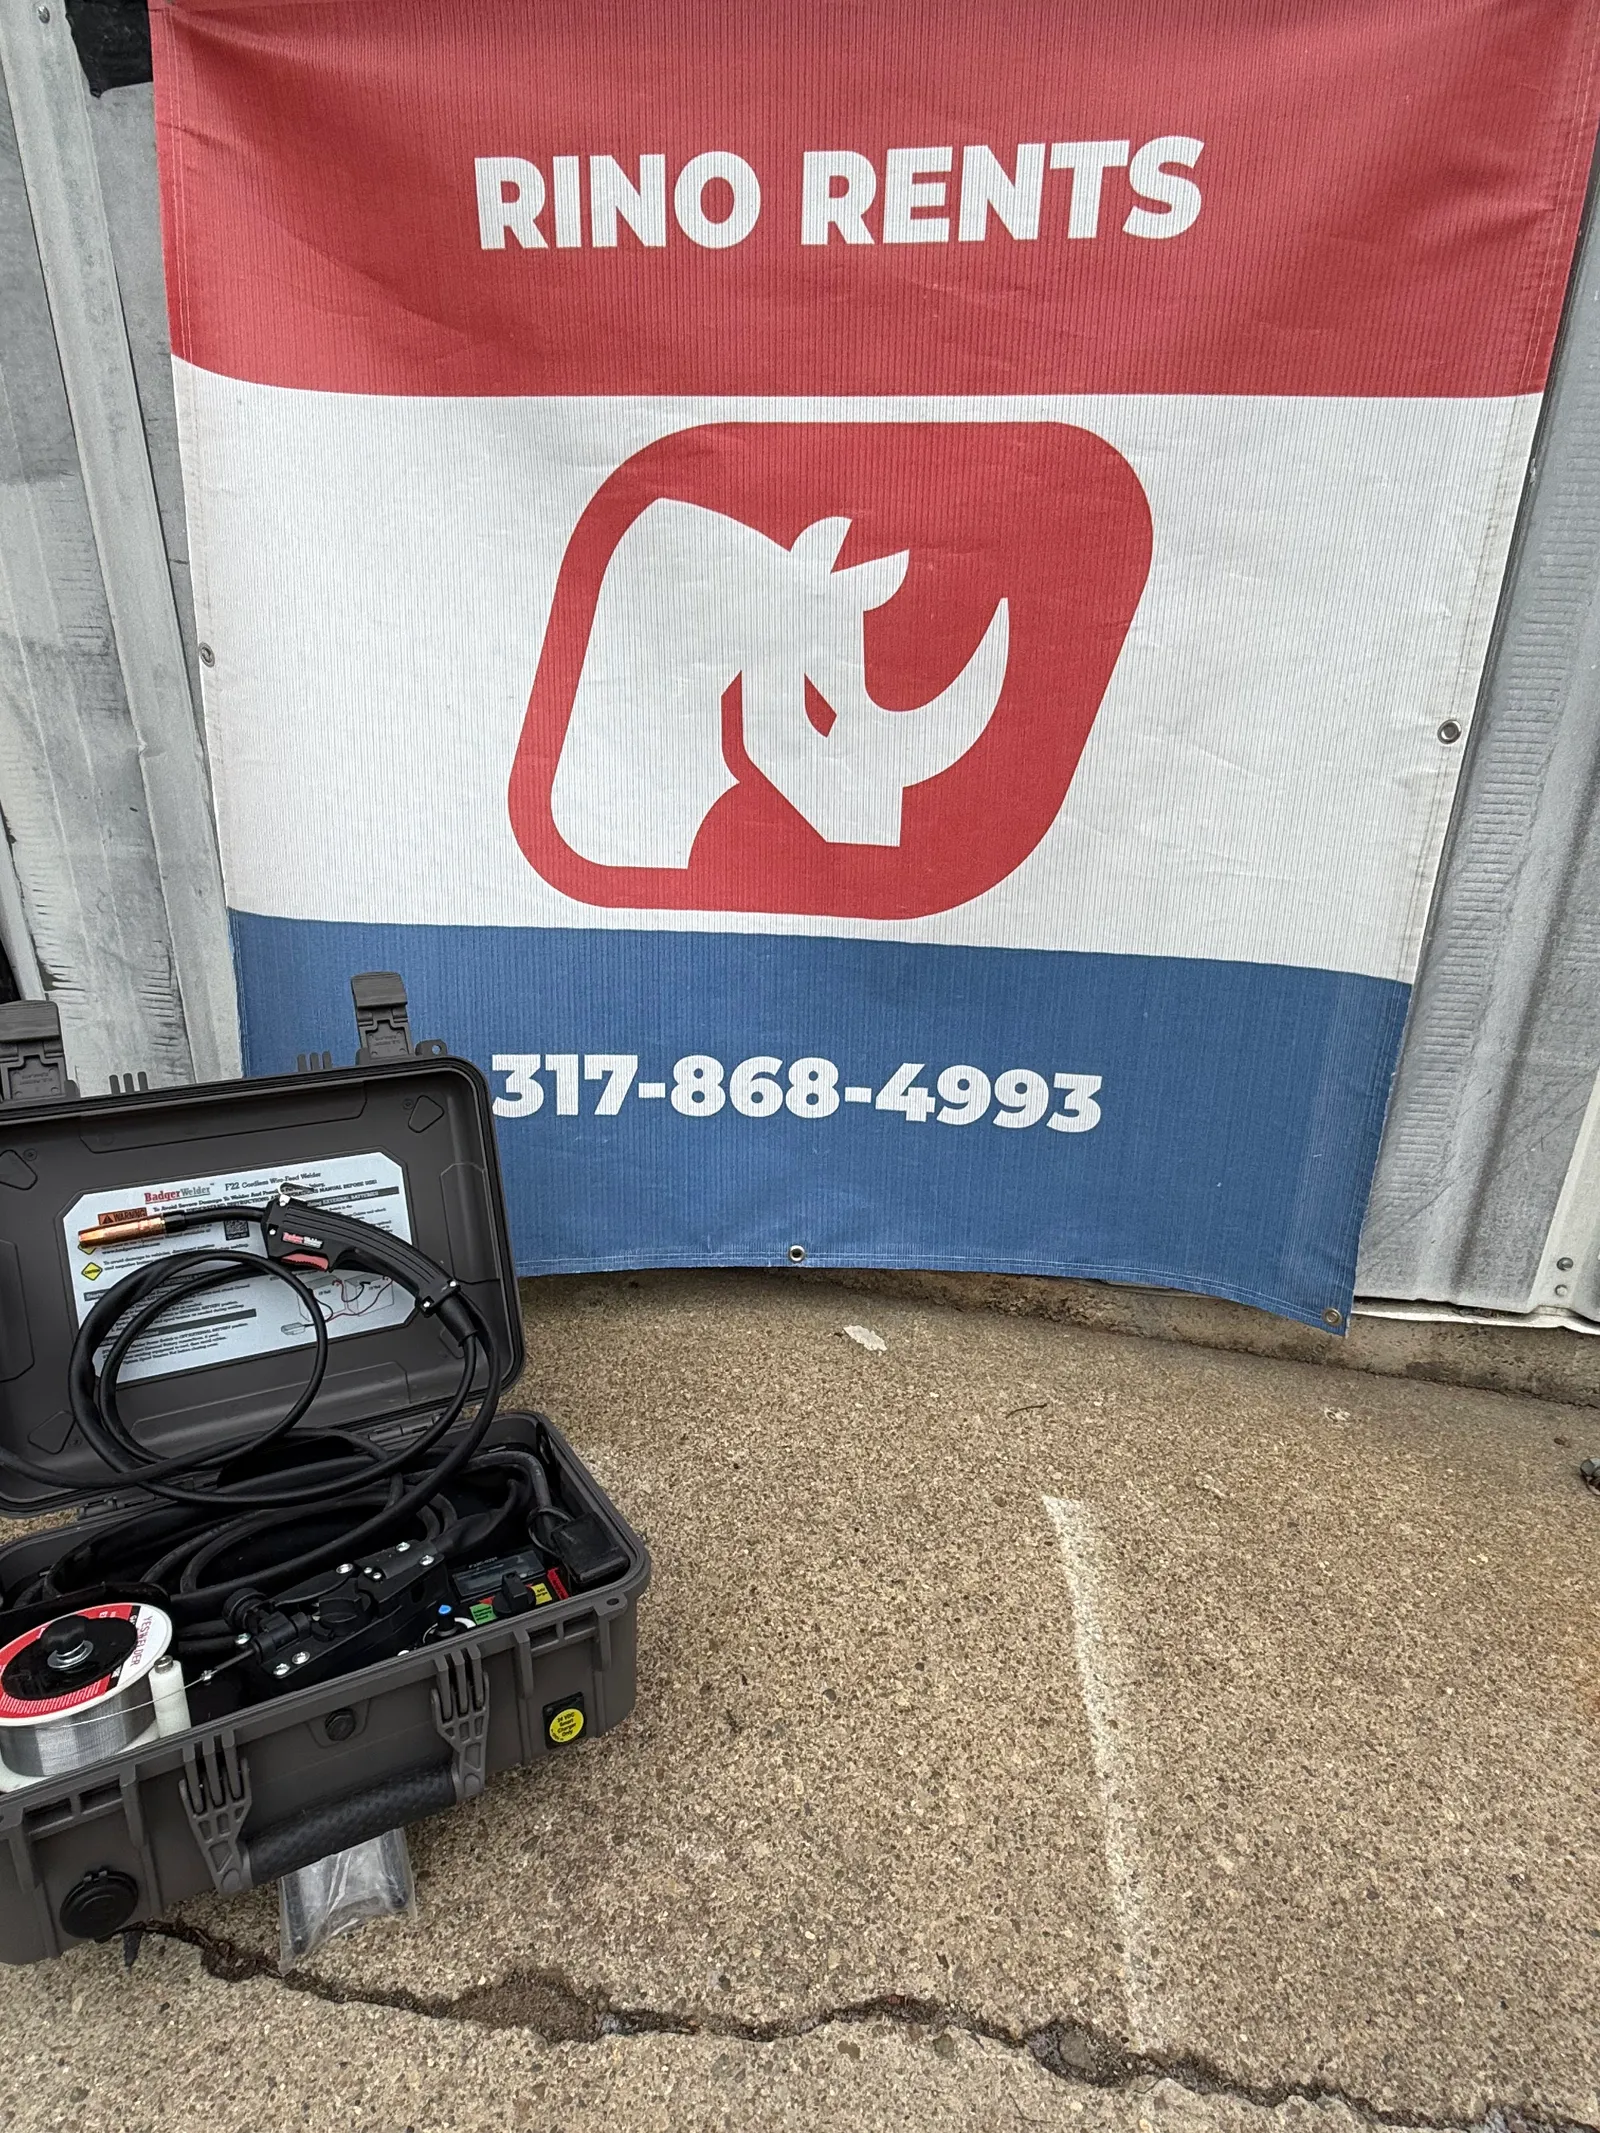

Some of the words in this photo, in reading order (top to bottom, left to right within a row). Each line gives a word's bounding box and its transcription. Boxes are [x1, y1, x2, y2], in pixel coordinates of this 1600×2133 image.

[474, 150, 762, 251] RINO
[800, 135, 1206, 246] RENTS
[491, 1053, 1103, 1134] 317-868-4993
[225, 1182, 241, 1191] F22
